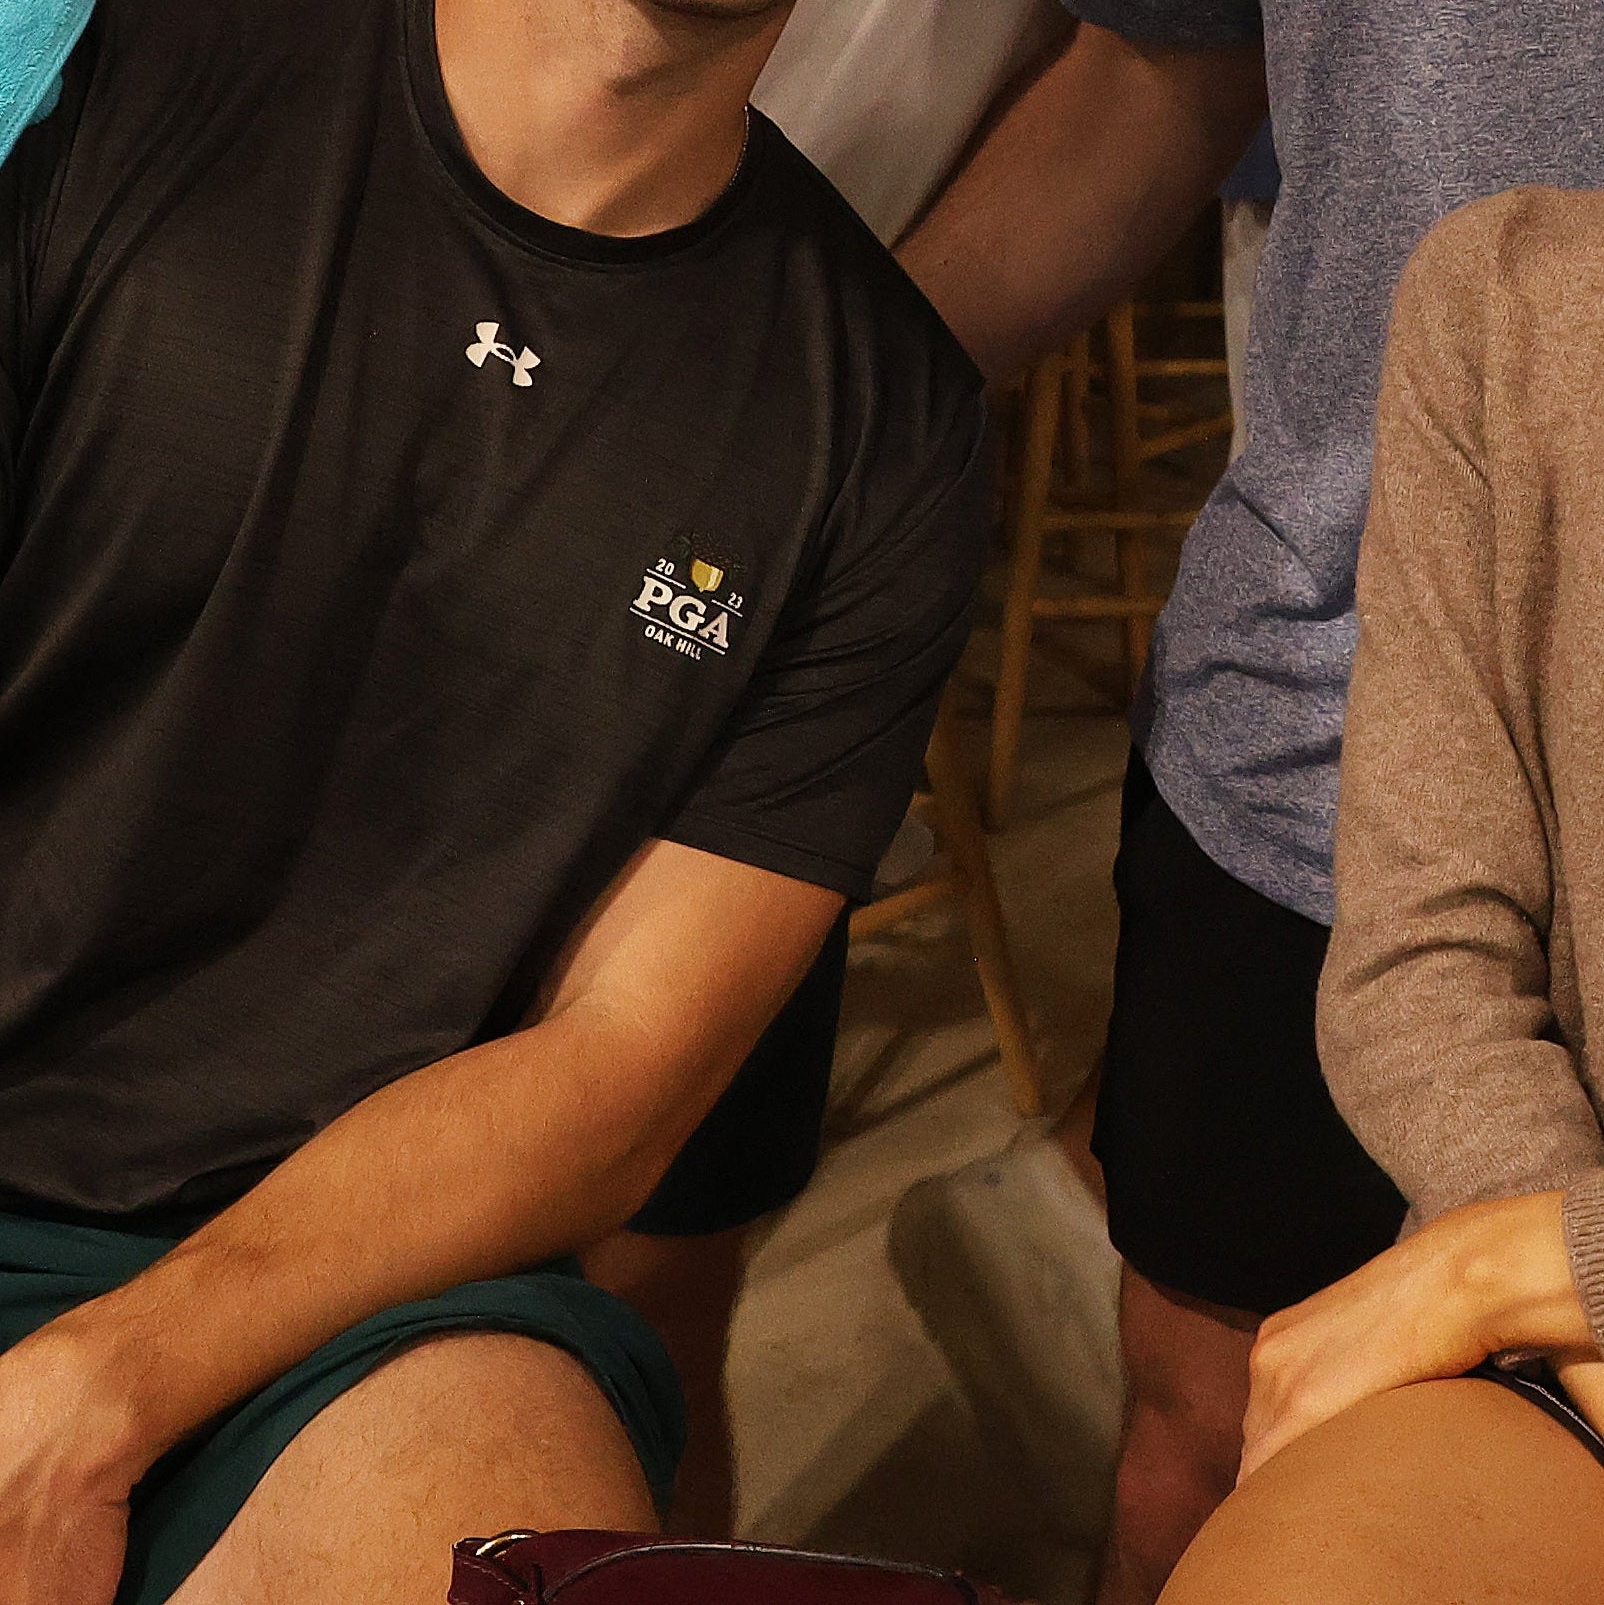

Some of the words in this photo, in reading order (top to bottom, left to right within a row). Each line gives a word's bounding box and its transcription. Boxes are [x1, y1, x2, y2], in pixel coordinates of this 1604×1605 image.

[655, 558, 675, 576] 20
[632, 576, 729, 648] PGA
[728, 592, 743, 609] 23
[644, 624, 675, 647] OAK
[675, 638, 702, 661] HILL
